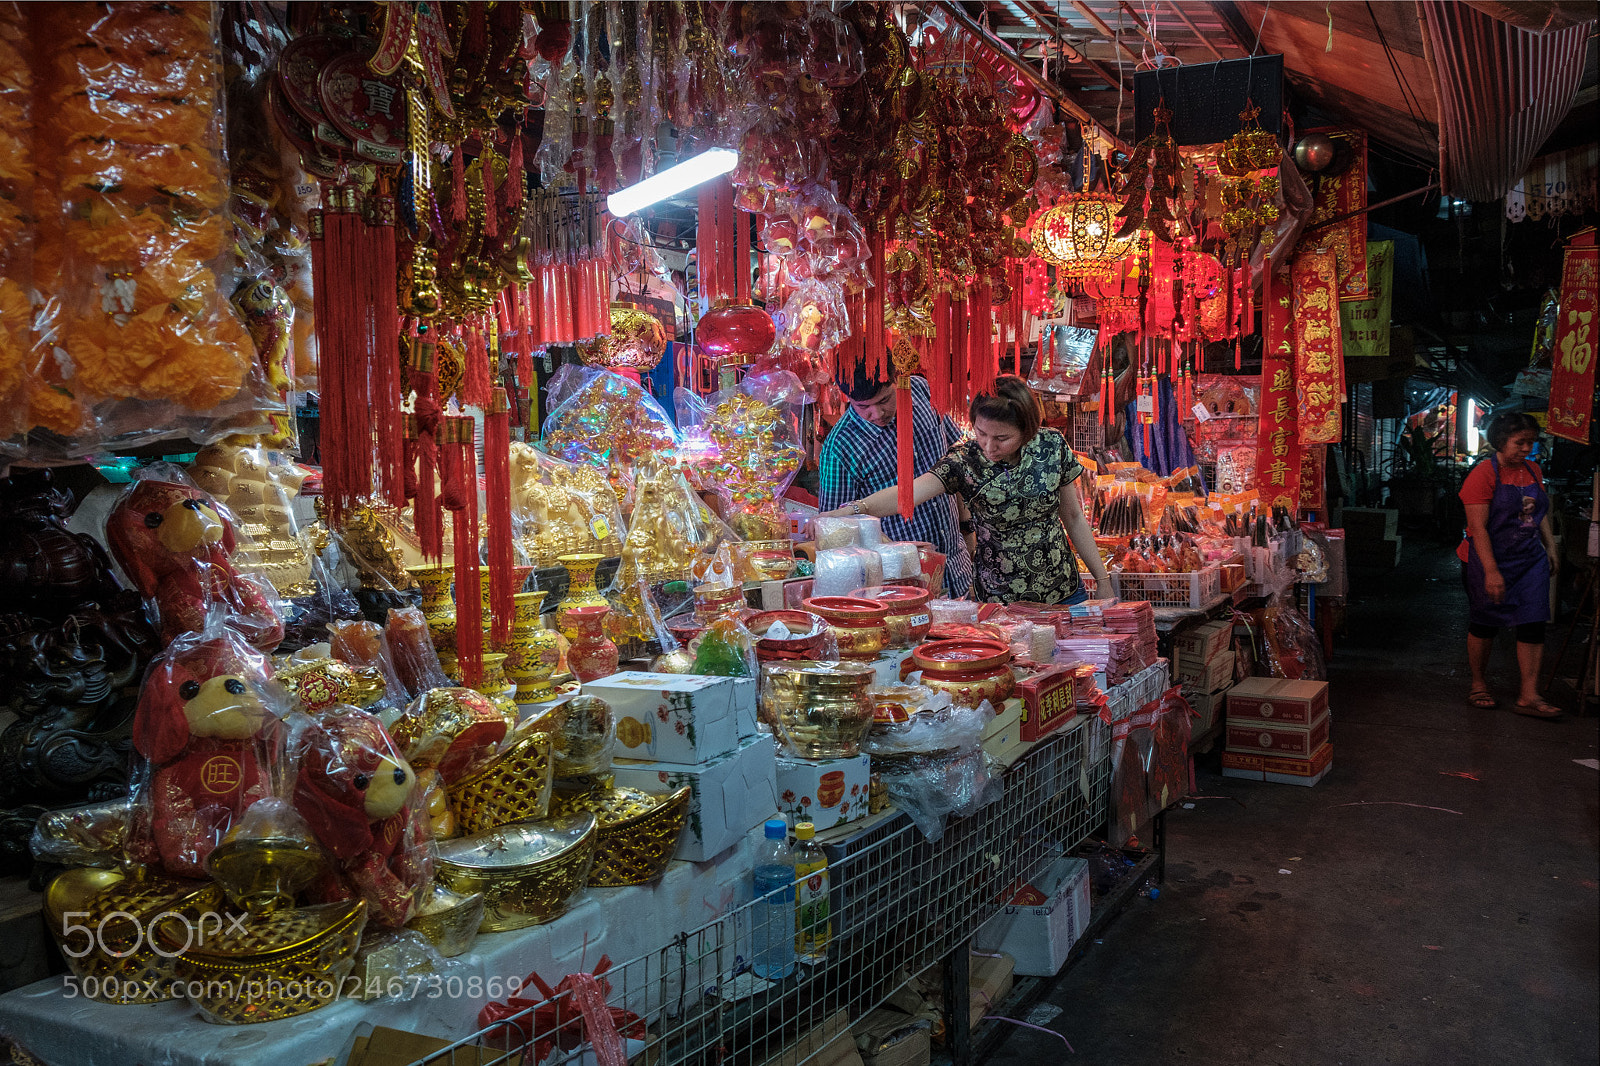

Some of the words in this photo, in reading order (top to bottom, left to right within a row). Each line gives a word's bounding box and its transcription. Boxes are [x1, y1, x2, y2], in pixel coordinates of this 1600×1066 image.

[360, 79, 397, 120] 寶
[1560, 309, 1593, 375] 福
[208, 763, 237, 785] 旺
